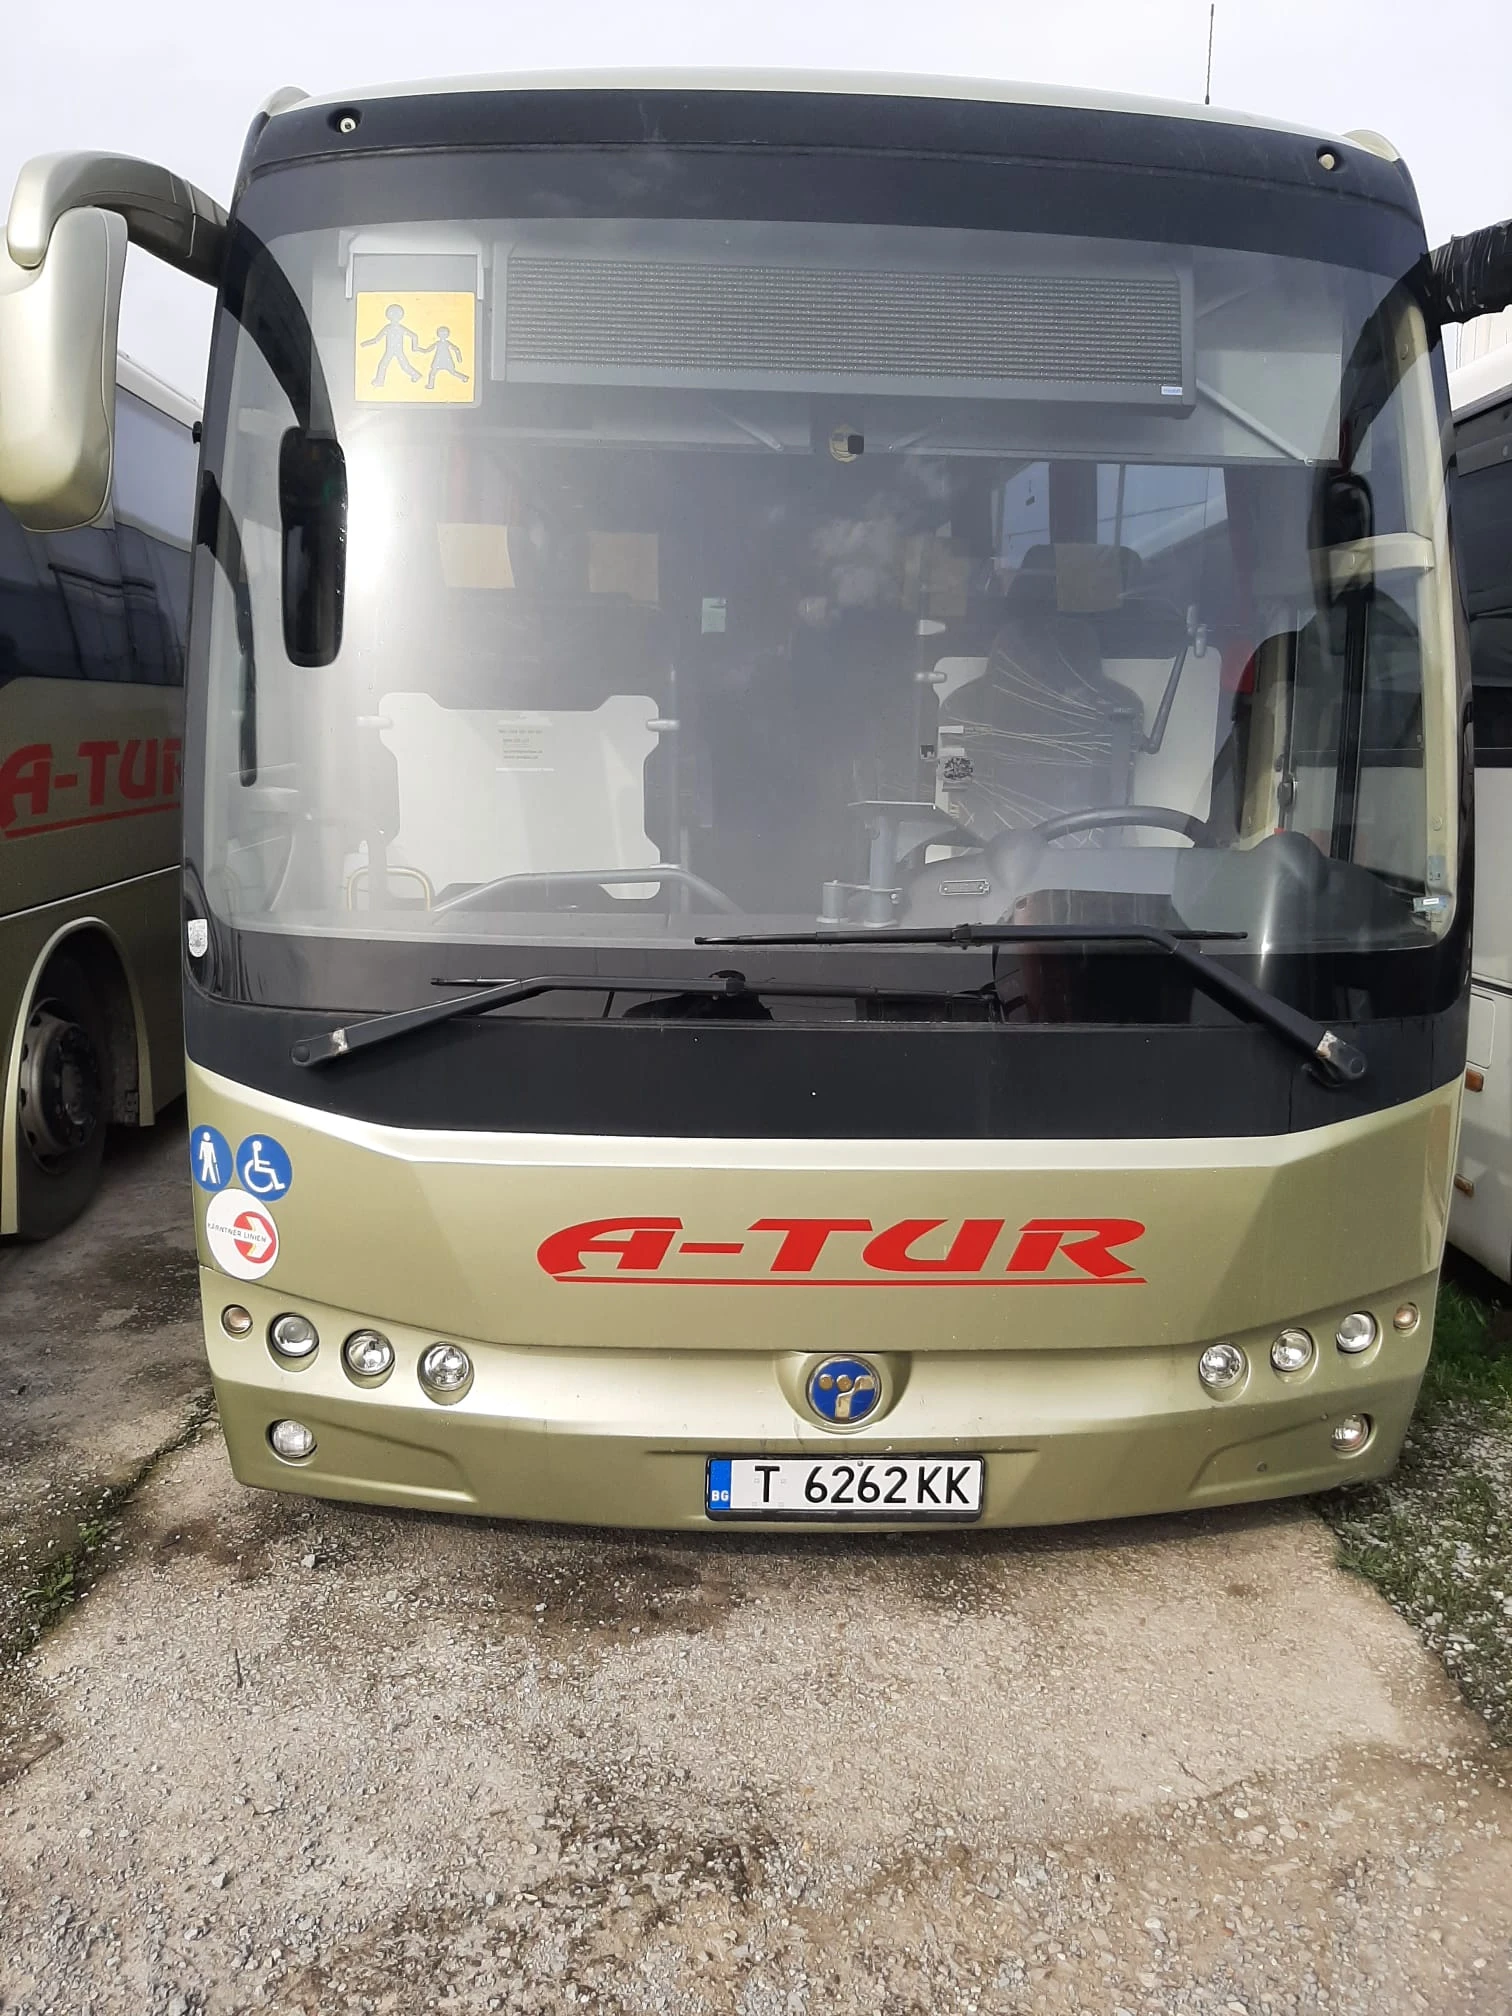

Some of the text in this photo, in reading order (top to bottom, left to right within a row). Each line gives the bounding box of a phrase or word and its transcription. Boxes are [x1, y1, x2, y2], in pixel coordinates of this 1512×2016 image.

[244, 1232, 267, 1243] LINIEN
[536, 1216, 1147, 1278] A-TUR
[711, 1489, 730, 1502] BG
[754, 1465, 781, 1504] T
